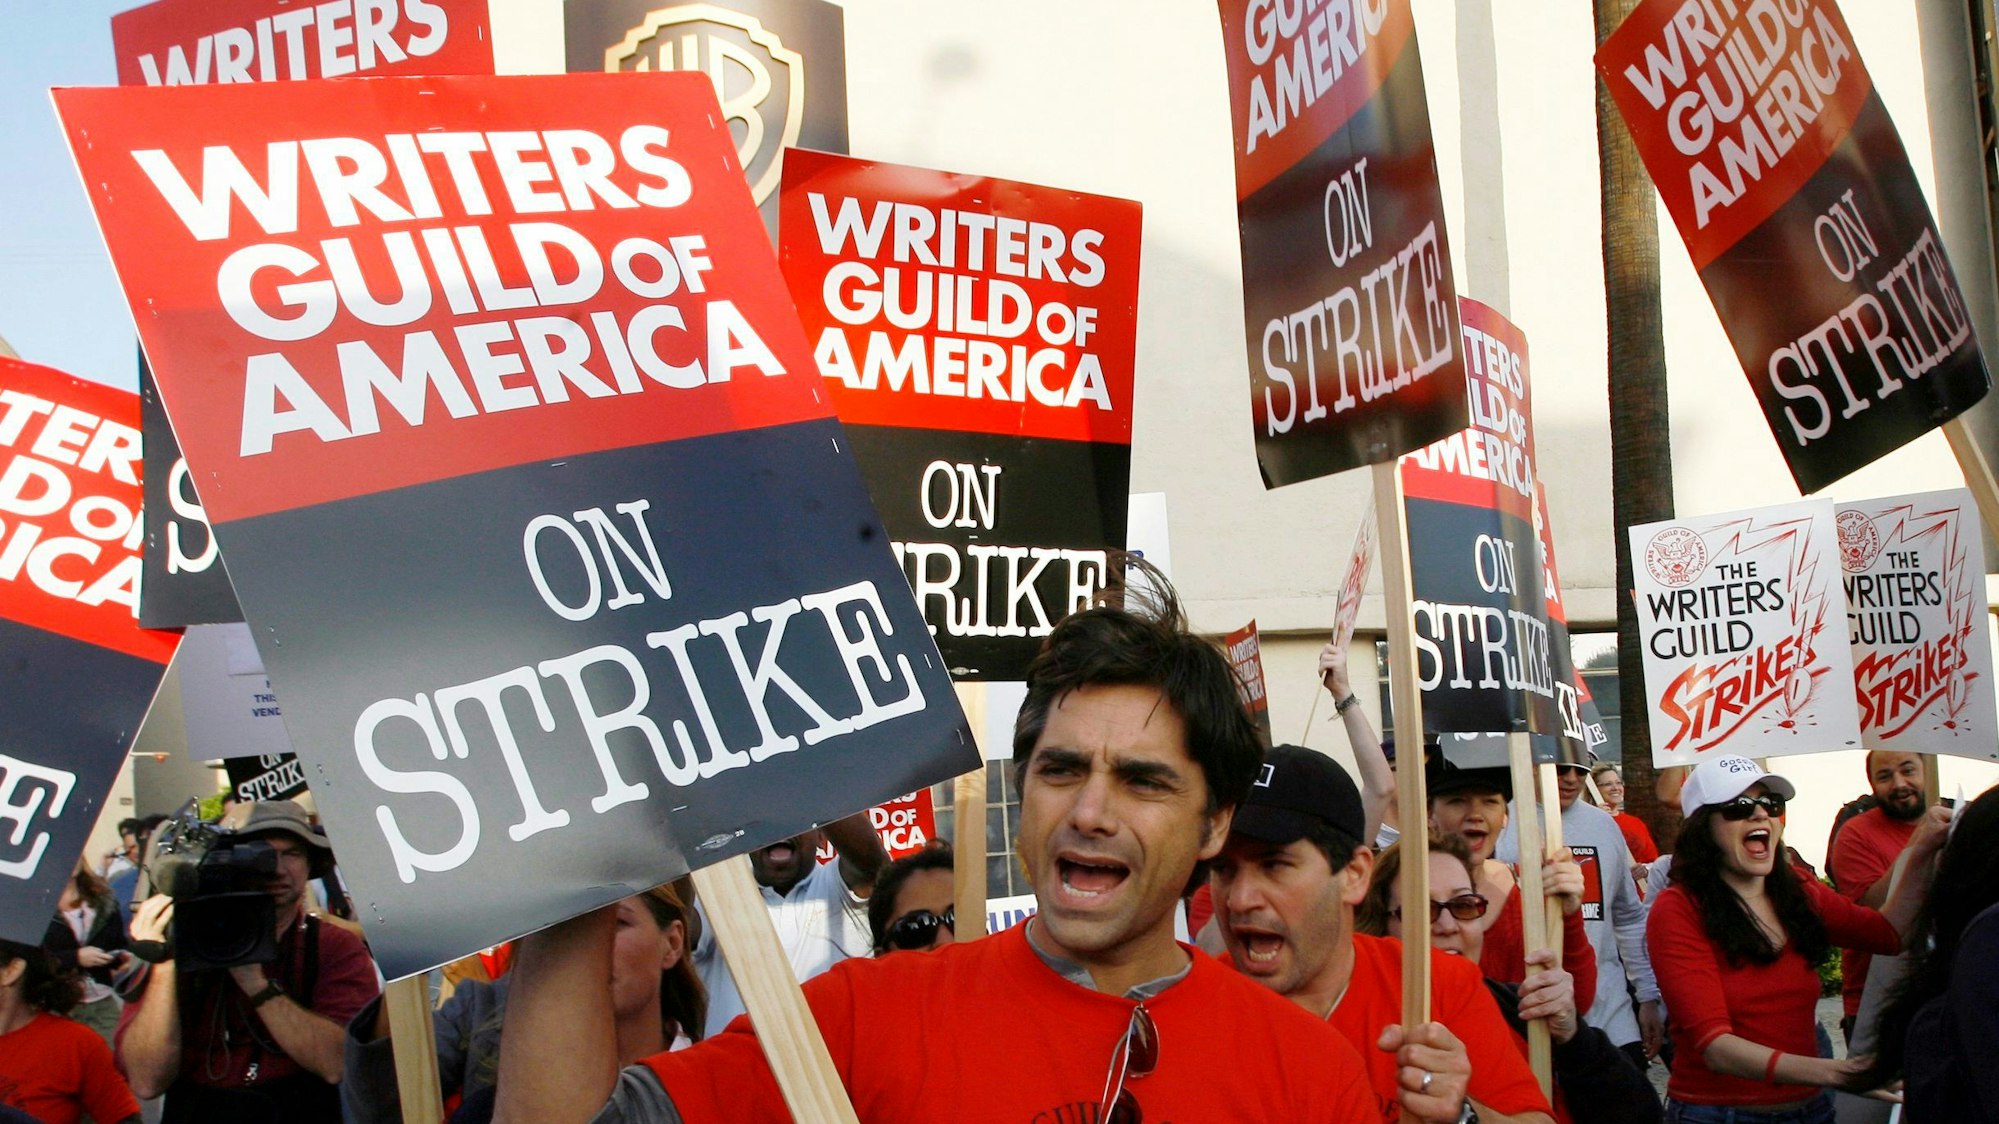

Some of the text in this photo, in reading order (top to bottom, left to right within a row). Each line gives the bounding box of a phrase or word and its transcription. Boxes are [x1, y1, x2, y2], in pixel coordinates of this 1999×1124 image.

[137, 0, 447, 86] WRITERS
[1247, 0, 1388, 155] AMERIC
[1667, 0, 1787, 155] GUILD
[1689, 6, 1850, 230] AMERICA
[131, 125, 692, 241] WRITERS
[1324, 157, 1372, 268] ON
[217, 222, 713, 342] GUILD OF
[807, 192, 1106, 287] WRITERS
[1814, 189, 1880, 283] ON
[822, 261, 1098, 347] GUILD OF
[1263, 221, 1453, 437] STRIKE
[1769, 227, 1970, 447] STRIKE
[239, 299, 787, 457] AMERICA
[813, 327, 1113, 411] AMERICA
[0, 388, 143, 487] TER
[1509, 408, 1527, 448] OF
[920, 459, 1001, 530] ON
[523, 500, 672, 621] ON
[891, 542, 1107, 637] RIKE
[1474, 534, 1516, 596] ON
[1647, 578, 1784, 623] WRITERS
[1715, 562, 1757, 581] THE
[1886, 551, 1920, 569] THE
[1412, 600, 1554, 698] STRIKE
[1650, 620, 1754, 660] GUILD
[353, 580, 927, 883] STRIKE
[891, 809, 917, 827] OF
[1572, 847, 1595, 856] GUILD
